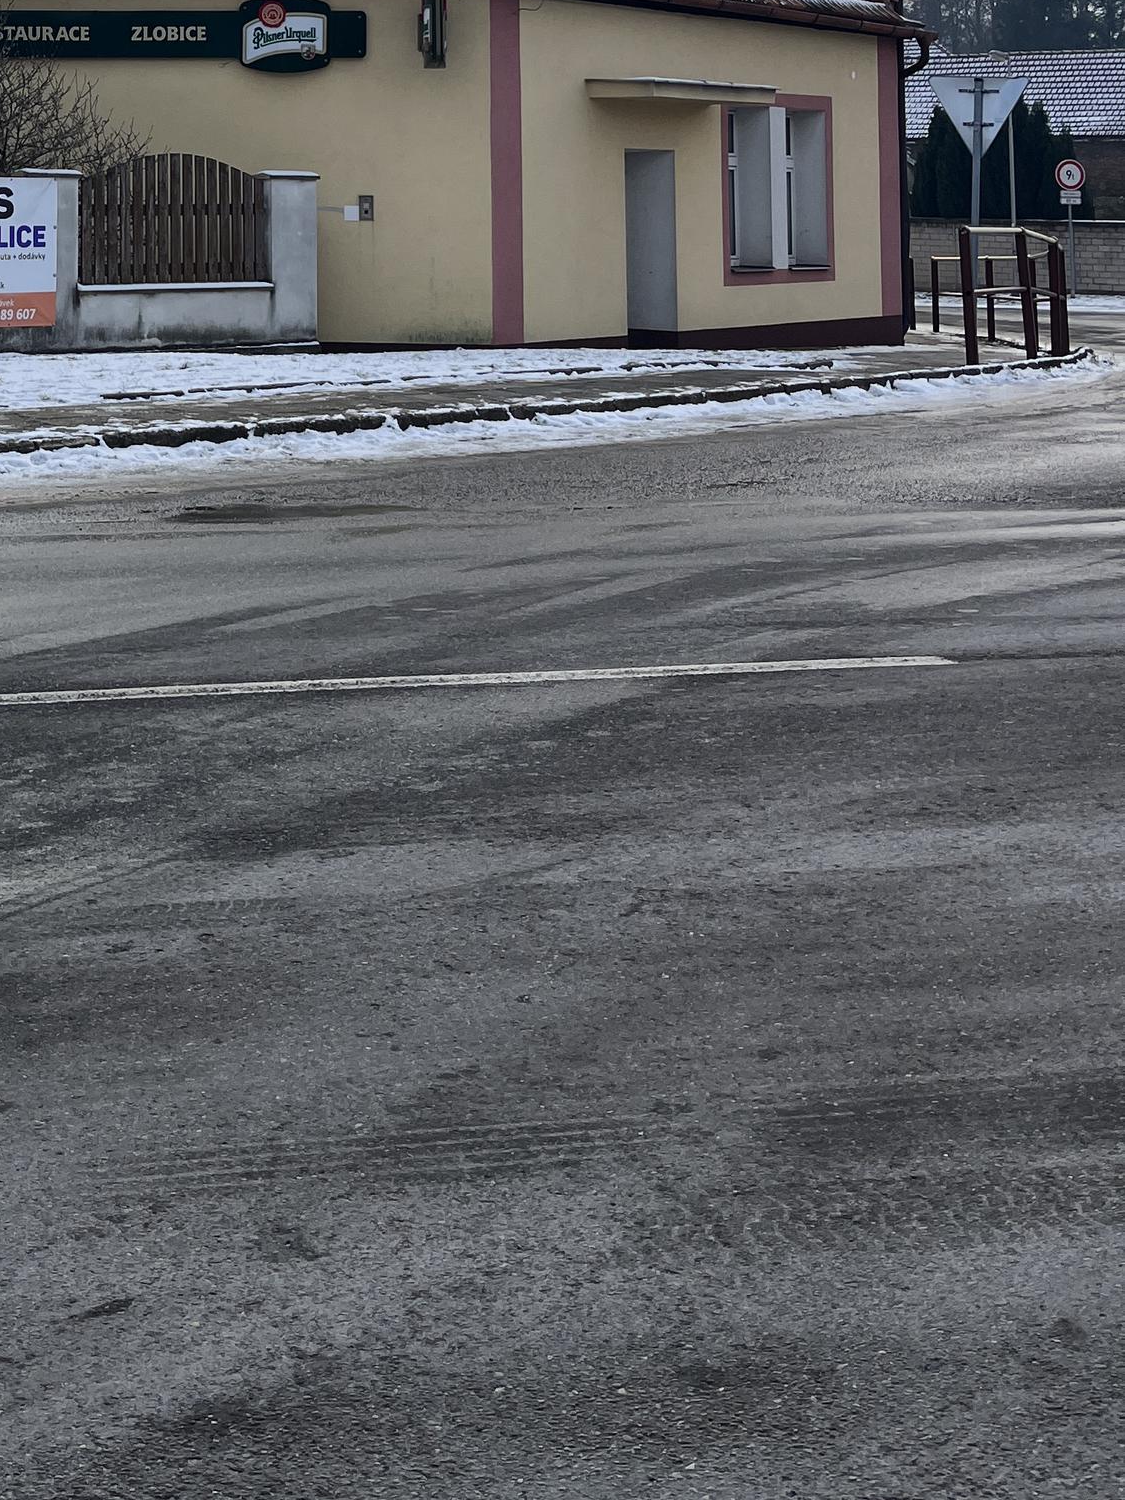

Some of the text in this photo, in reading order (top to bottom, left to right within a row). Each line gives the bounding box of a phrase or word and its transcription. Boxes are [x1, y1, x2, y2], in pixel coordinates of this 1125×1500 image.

[131, 26, 207, 40] ZLOBICE
[253, 26, 316, 49] Pilsner Urquell
[18, 252, 46, 261] dodávky
[16, 308, 36, 320] 607
